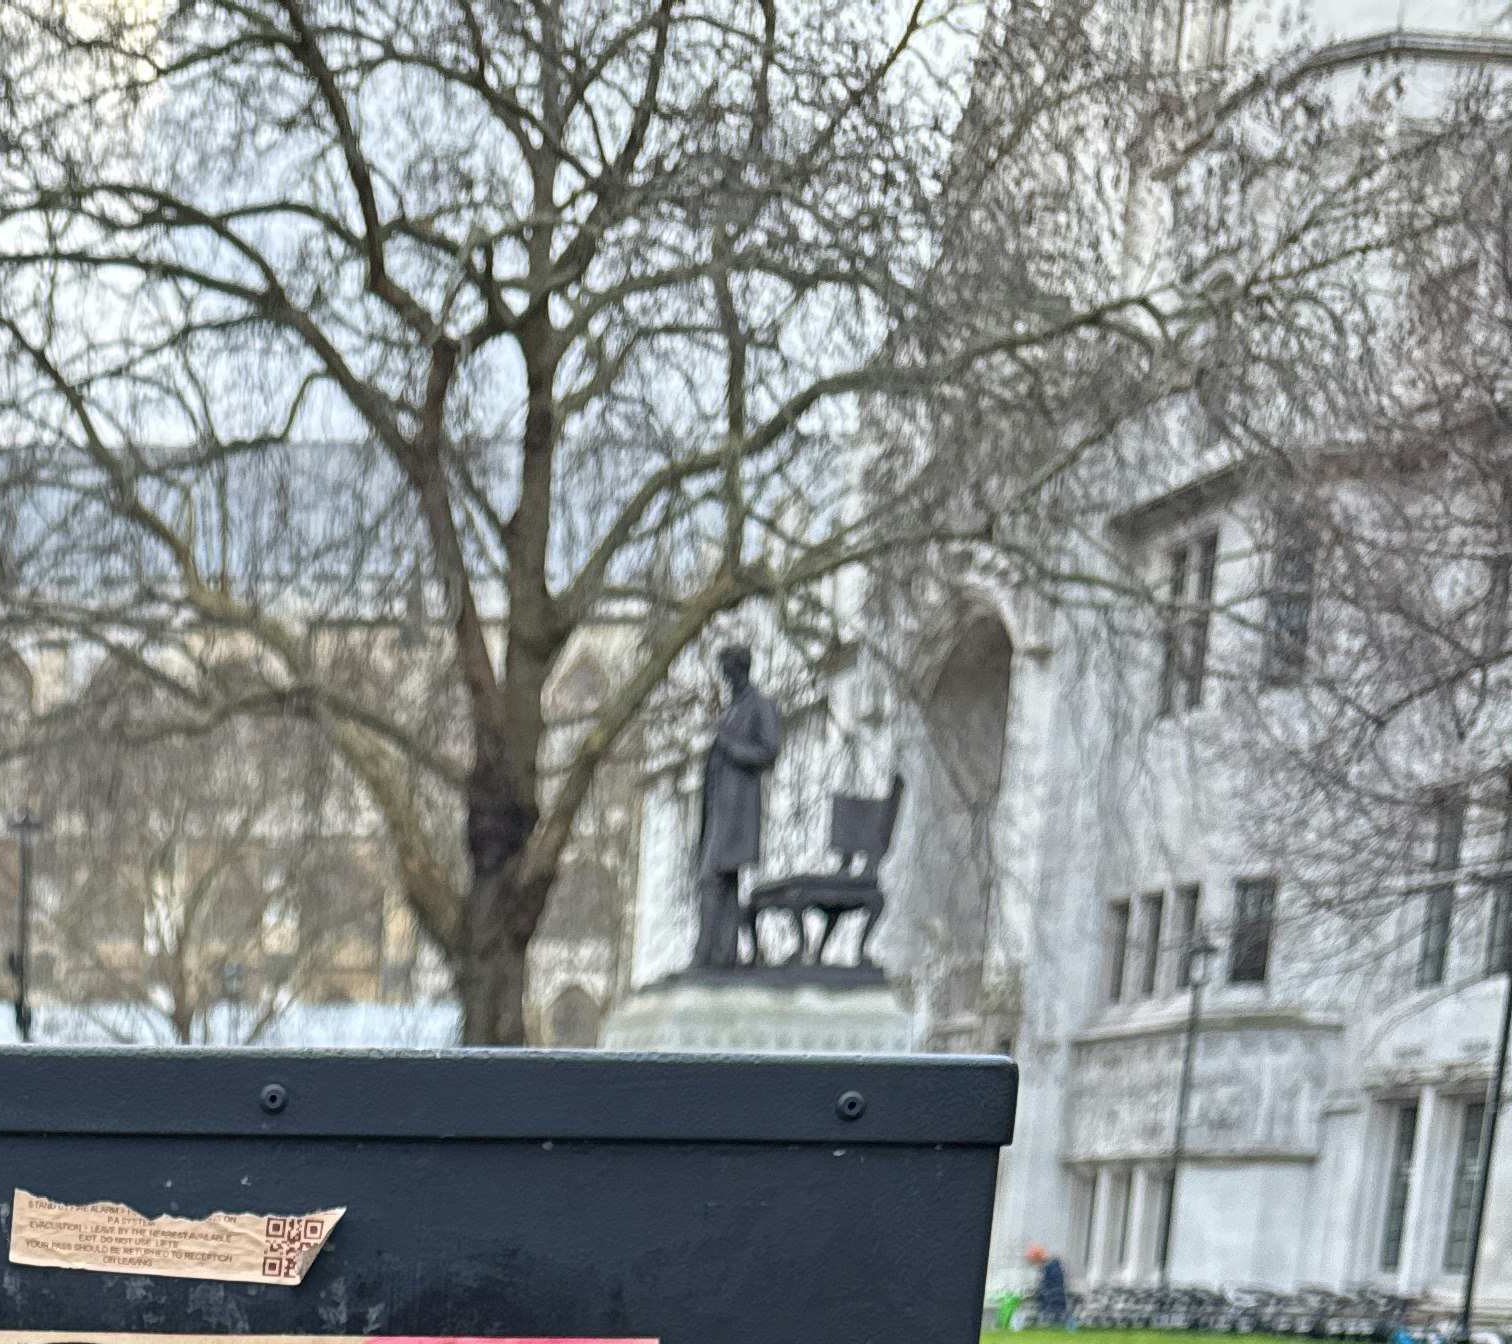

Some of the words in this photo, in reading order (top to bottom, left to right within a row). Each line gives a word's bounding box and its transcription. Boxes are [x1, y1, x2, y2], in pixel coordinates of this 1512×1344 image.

[29, 1220, 82, 1233] EVACUATION
[90, 1225, 116, 1236] LEAVE
[117, 1227, 130, 1236] BY
[131, 1227, 148, 1238] THE
[149, 1229, 188, 1241] NEAREST
[78, 1233, 97, 1243] EXIT
[100, 1235, 114, 1244] DO
[115, 1236, 133, 1246] NOT
[134, 1237, 152, 1247] USE
[155, 1239, 179, 1249] LIFTS
[26, 1239, 49, 1249] YOUR
[51, 1241, 74, 1251] PASS
[74, 1243, 109, 1255] SHOULD
[111, 1246, 122, 1255] BE
[171, 1250, 182, 1260] TO
[184, 1252, 233, 1263] RECEPTION
[117, 1257, 153, 1267] LEAVING
